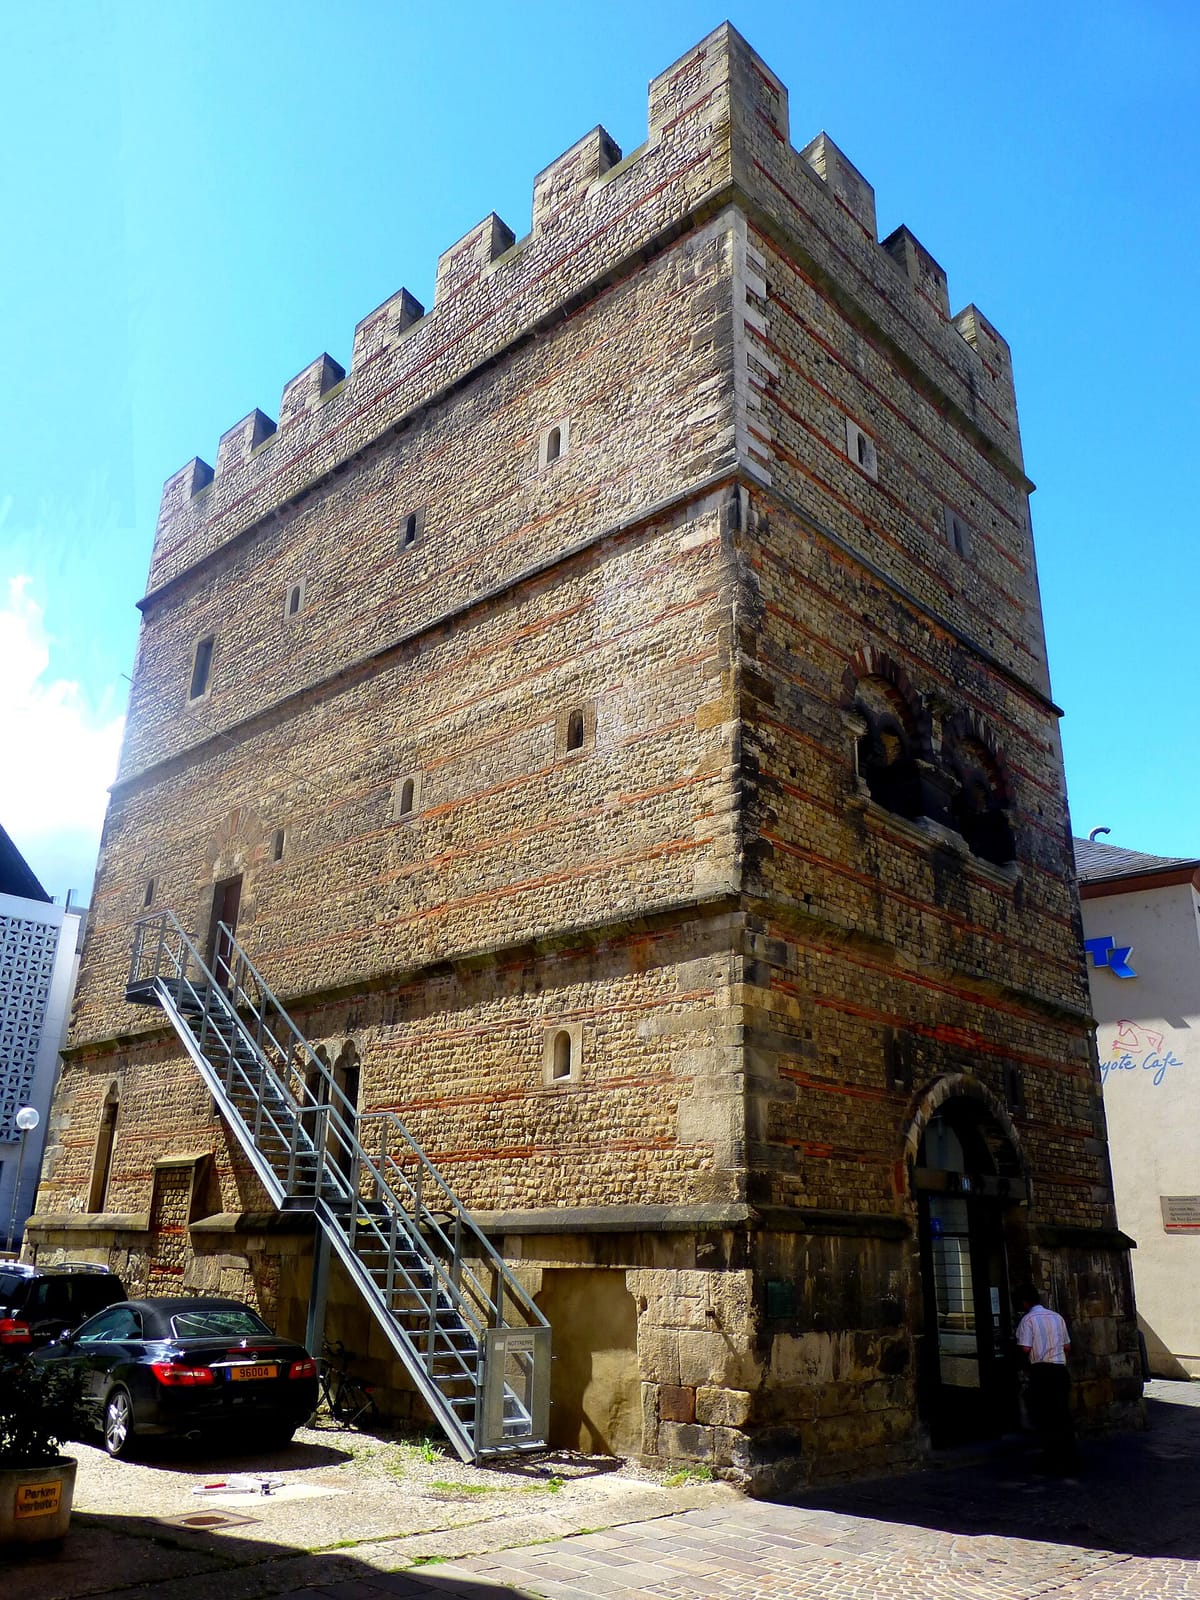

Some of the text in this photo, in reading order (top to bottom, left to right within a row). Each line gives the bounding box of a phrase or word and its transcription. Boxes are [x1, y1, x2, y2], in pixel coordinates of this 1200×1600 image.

[1100, 1053, 1136, 1085] yote
[239, 1367, 269, 1378] 96004
[25, 1487, 56, 1500] Parken
